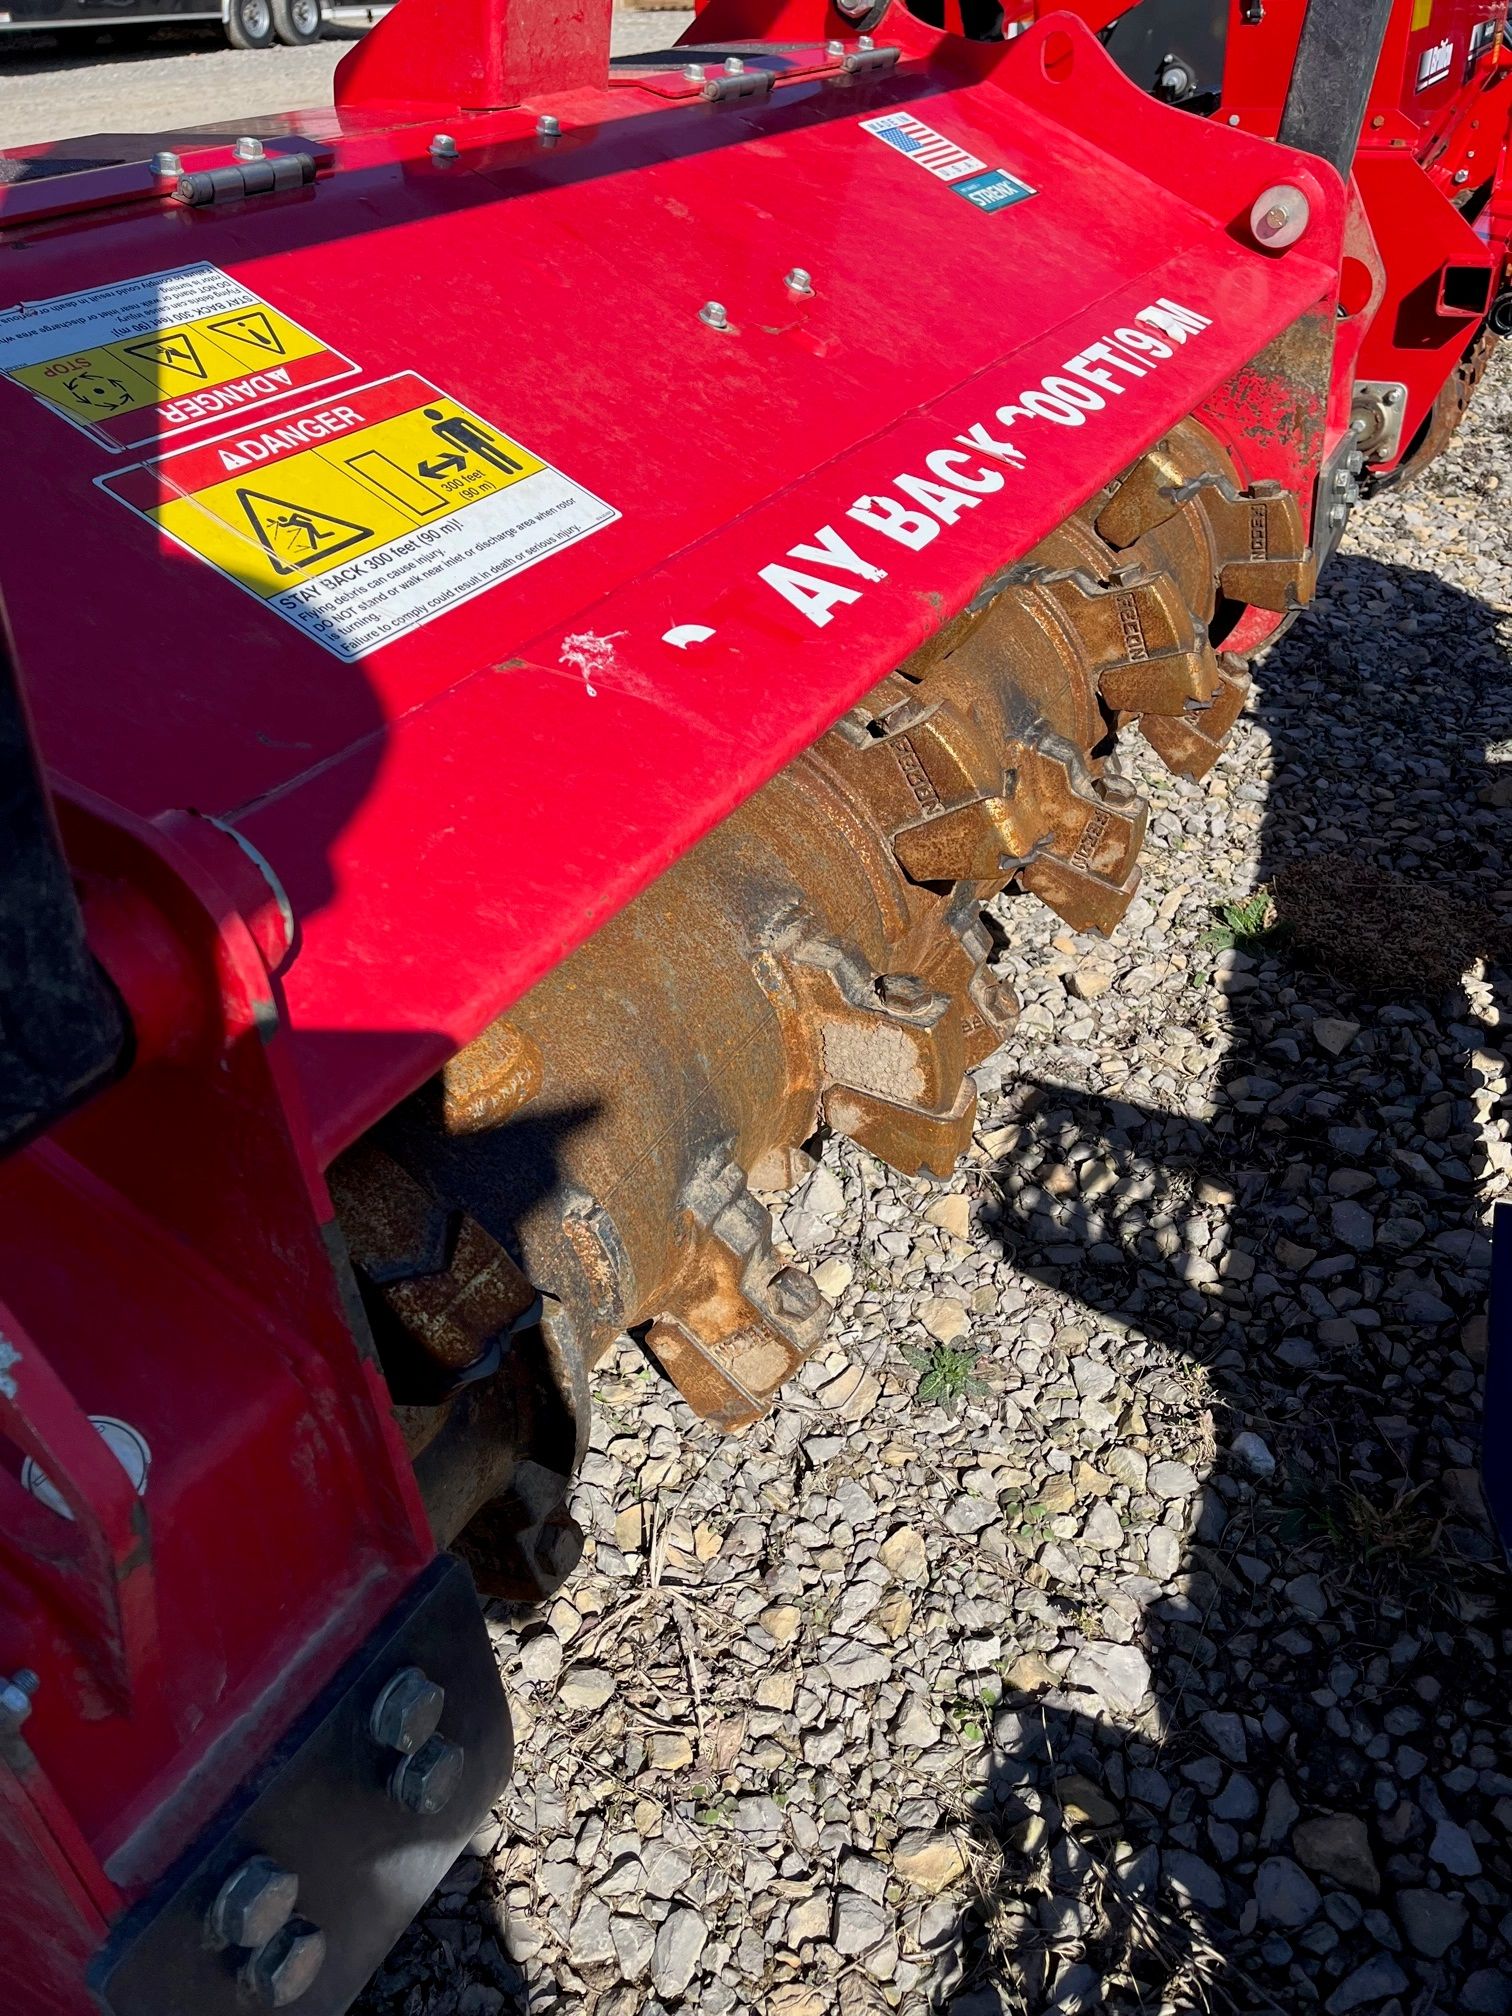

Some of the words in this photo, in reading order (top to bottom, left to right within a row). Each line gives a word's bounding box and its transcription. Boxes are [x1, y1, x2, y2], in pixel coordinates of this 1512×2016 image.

[867, 118, 898, 131] MADE
[897, 115, 912, 124] IN
[181, 267, 212, 278] Failure
[199, 274, 222, 283] rotor
[138, 274, 173, 288] comply
[87, 290, 116, 302] result
[114, 284, 140, 295] could
[170, 288, 198, 299] stand
[212, 286, 242, 298] Flying
[48, 300, 78, 312] death
[138, 297, 162, 307] walk
[186, 294, 215, 304] debris
[224, 294, 254, 308] STAY
[96, 308, 120, 318] inlet
[118, 302, 140, 312] near
[142, 304, 170, 316] cause
[190, 301, 227, 316] BACK
[37, 316, 86, 333] discharge
[148, 315, 174, 327] feet
[14, 328, 38, 339] area
[44, 357, 92, 378] STOP
[155, 375, 278, 423] DANGER
[235, 405, 366, 461] DANGER
[441, 478, 465, 492] 300
[461, 469, 486, 483] feet
[845, 422, 1027, 551] BACK
[459, 487, 480, 501] (90
[479, 480, 497, 492] m)
[1251, 503, 1267, 560] FECON
[278, 584, 323, 610] STAY
[318, 563, 369, 590] BACK
[362, 551, 394, 570] 300
[388, 538, 421, 558] feet
[414, 528, 444, 546] (90
[436, 518, 466, 535] m)!
[311, 618, 334, 632] DO
[330, 606, 358, 623] NOT
[355, 590, 389, 610] stand
[386, 586, 400, 596] or
[396, 574, 424, 590] walk
[420, 564, 446, 578] near
[440, 552, 466, 568] inlet
[462, 548, 476, 556] or
[472, 527, 520, 552] discharge
[514, 518, 536, 530] area
[532, 506, 558, 520] when
[553, 496, 577, 510] rotor
[296, 600, 336, 622] Flying
[332, 584, 368, 604] debris
[366, 576, 388, 588] can
[384, 562, 417, 580] cause
[412, 546, 447, 566] injury.
[339, 628, 380, 652] Failure
[375, 622, 392, 633] to
[388, 603, 430, 627] comply
[424, 588, 456, 608] could
[451, 574, 482, 593] result
[476, 570, 492, 579] in
[488, 557, 517, 574] death
[512, 552, 527, 560] or
[522, 536, 557, 556] serious
[552, 523, 584, 540] injury.
[324, 630, 341, 642] is
[336, 610, 383, 636] turning.
